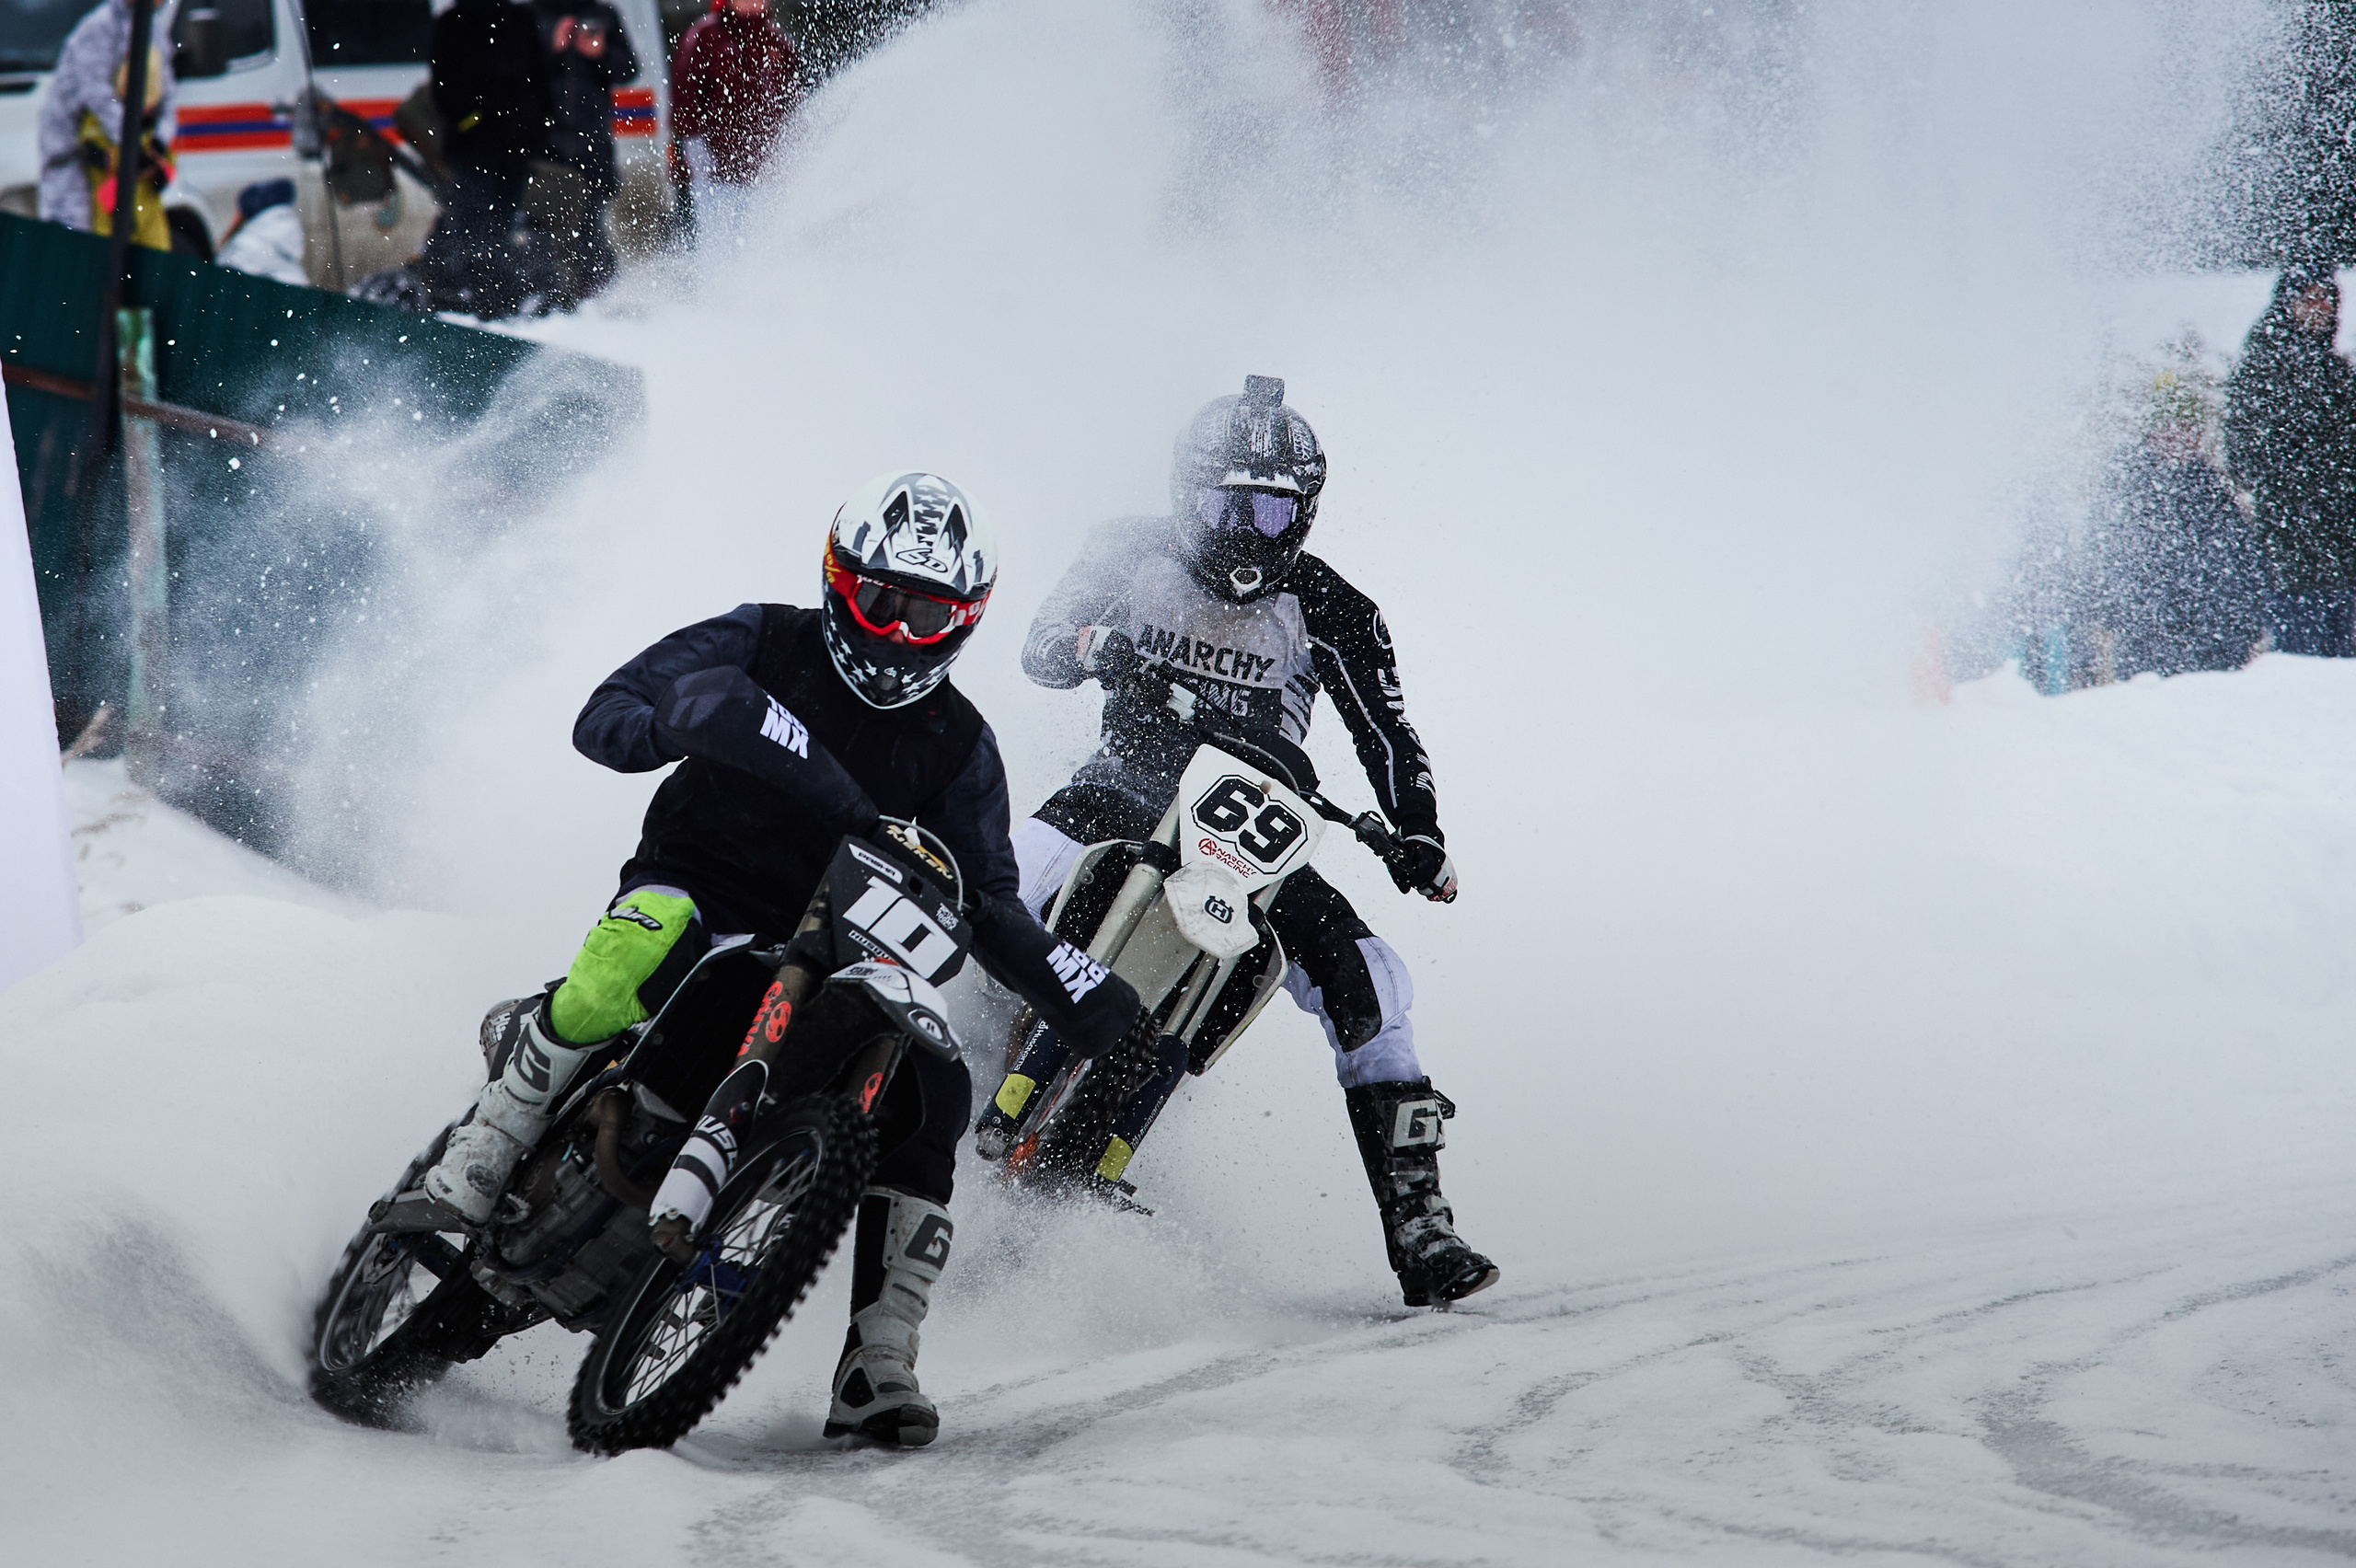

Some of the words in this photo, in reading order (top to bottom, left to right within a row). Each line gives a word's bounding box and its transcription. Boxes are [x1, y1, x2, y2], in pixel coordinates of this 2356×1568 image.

[1137, 623, 1276, 682] ANARCHY
[759, 706, 810, 759] MX
[1195, 778, 1303, 863] 69
[886, 829, 953, 880] NEKEN
[842, 876, 959, 980] 10
[1045, 944, 1098, 1004] MX
[1013, 1028, 1045, 1072] Husqvarna
